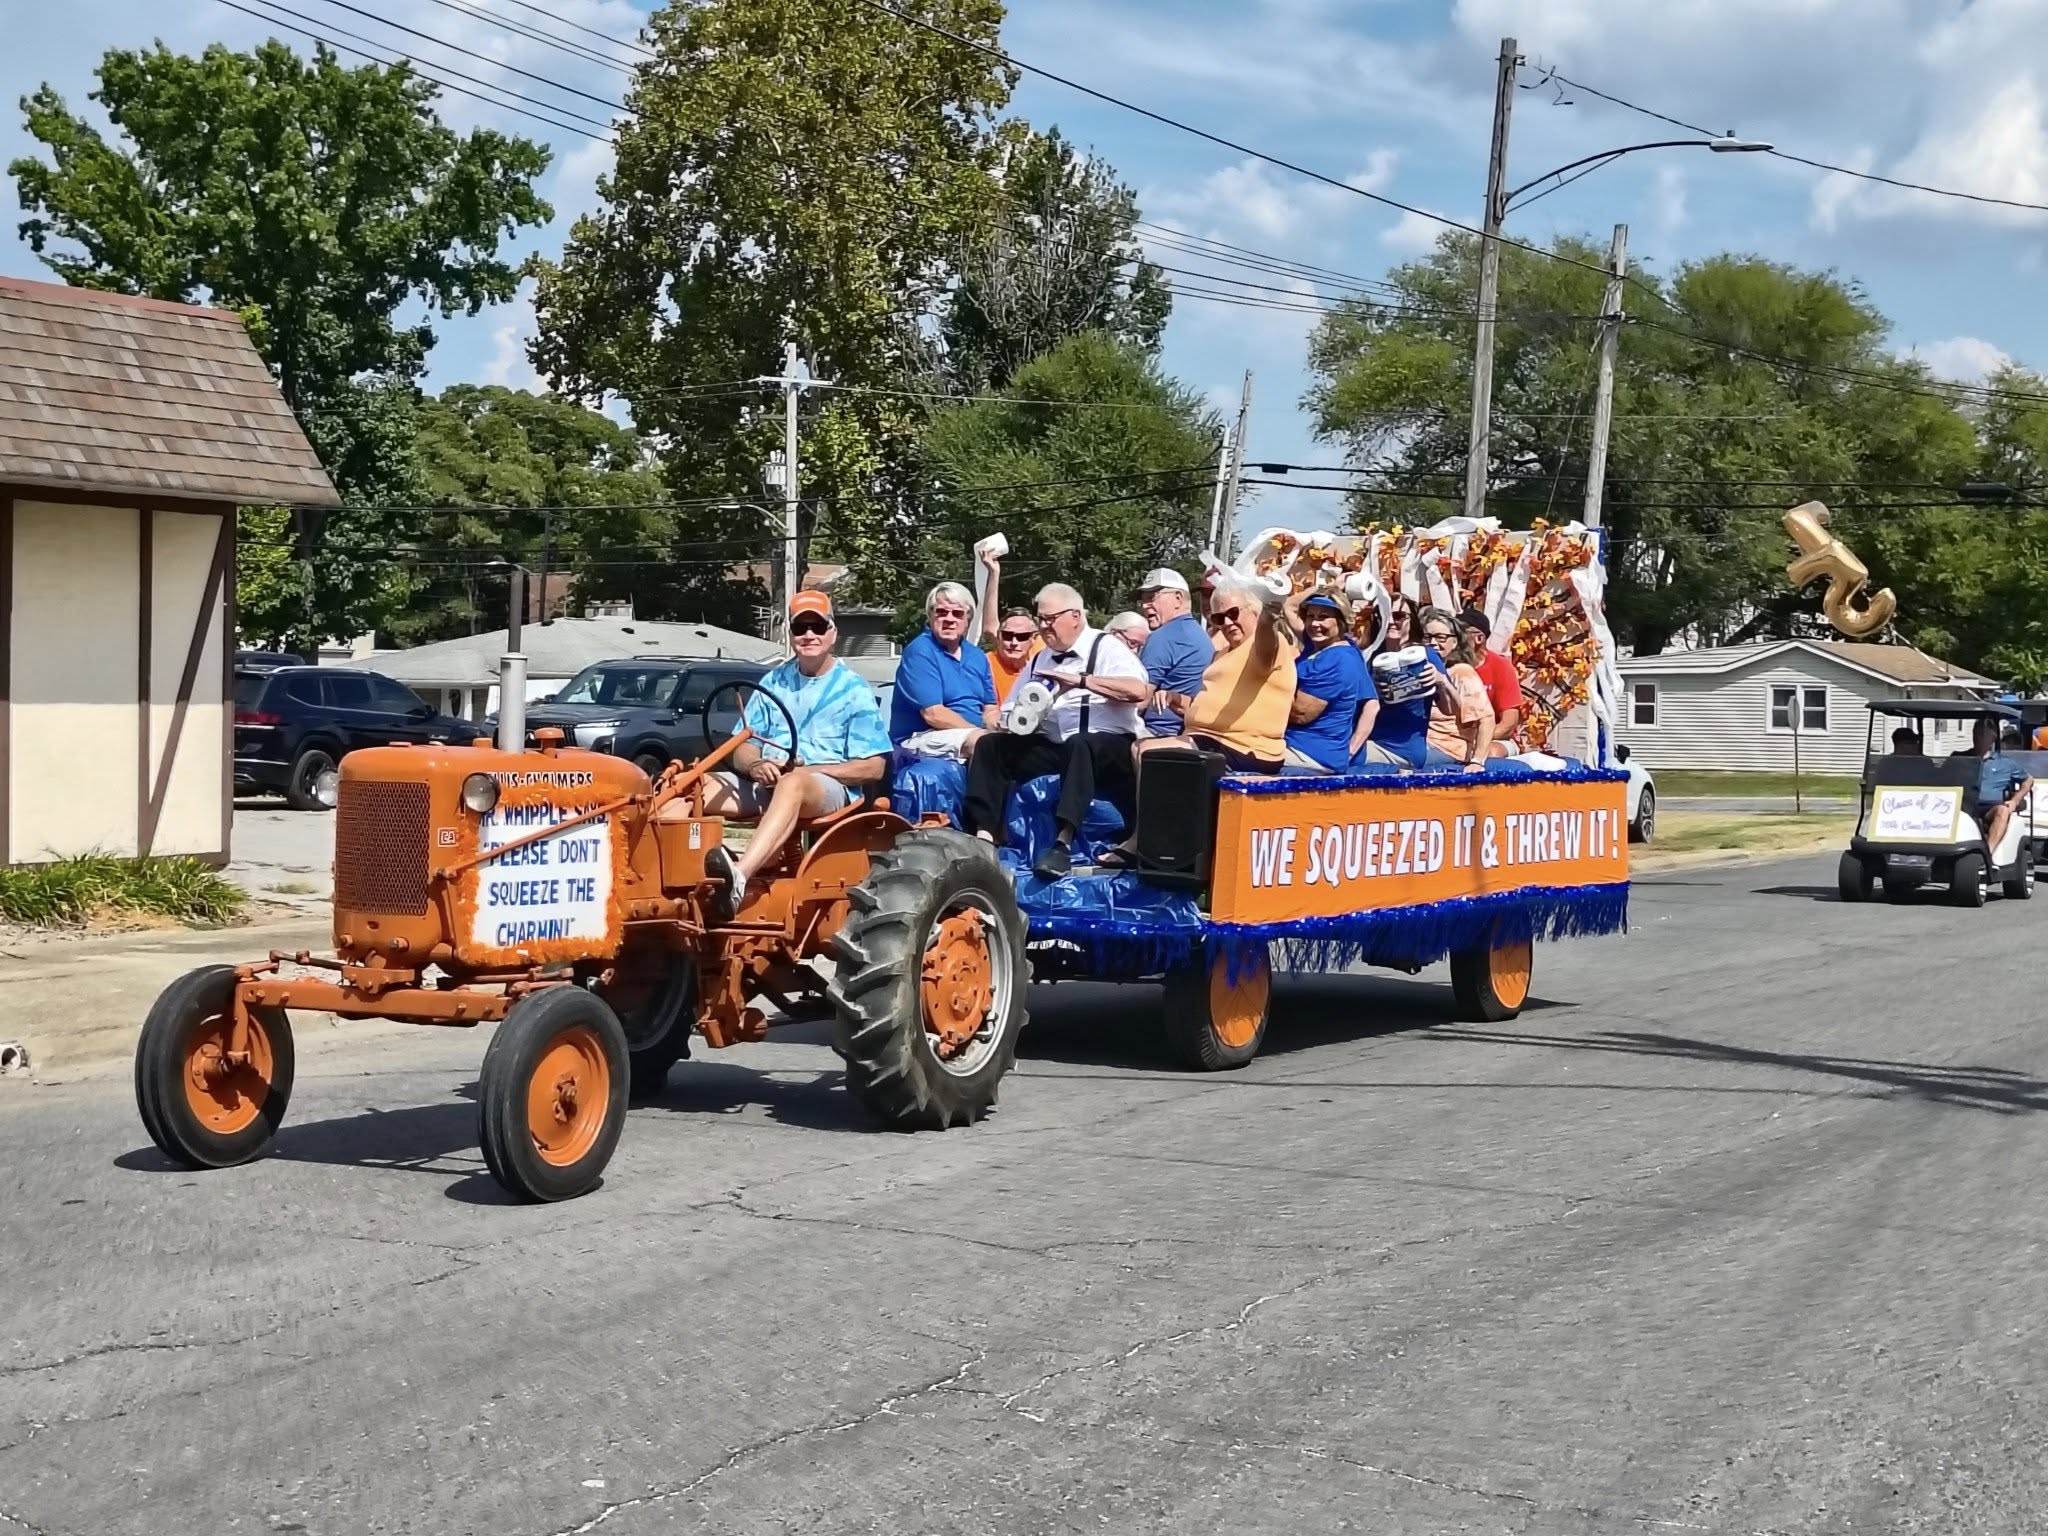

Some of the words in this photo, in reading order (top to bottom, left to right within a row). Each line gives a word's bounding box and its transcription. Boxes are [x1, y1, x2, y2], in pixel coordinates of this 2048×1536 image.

[504, 801, 567, 826] WHIPPLE
[1882, 797, 1913, 814] Class
[1915, 793, 1929, 810] of
[559, 839, 600, 864] DON'T
[1251, 826, 1298, 888] WE
[1304, 819, 1446, 888] SQUEEZED
[1453, 814, 1476, 868] IT
[1480, 815, 1500, 869] &
[1505, 811, 1584, 865] THREW
[488, 879, 559, 906] SQUEEZE
[566, 878, 596, 903] THE
